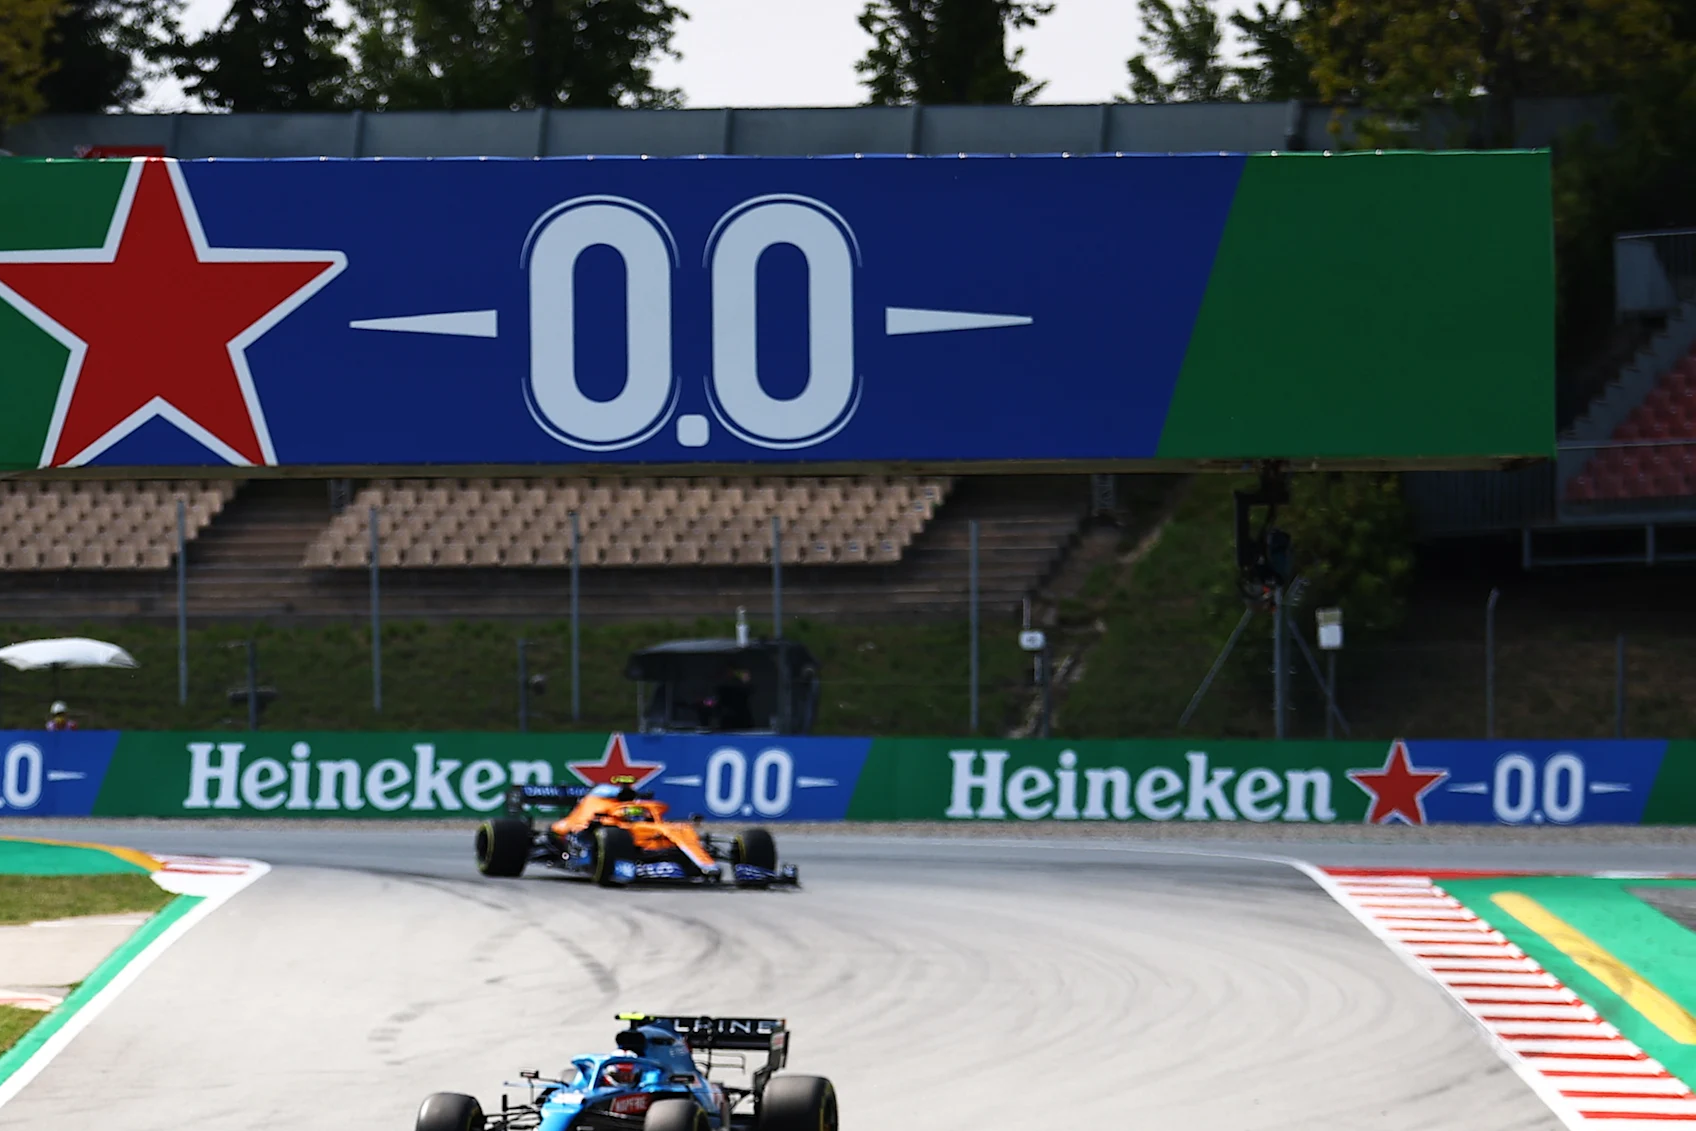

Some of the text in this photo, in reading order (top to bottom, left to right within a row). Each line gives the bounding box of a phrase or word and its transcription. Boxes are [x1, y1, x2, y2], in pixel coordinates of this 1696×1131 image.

[524, 196, 859, 450] 0.0
[706, 747, 794, 816] 0.0
[946, 750, 1586, 823] Heineken 0.0
[673, 1019, 773, 1034] LPINE
